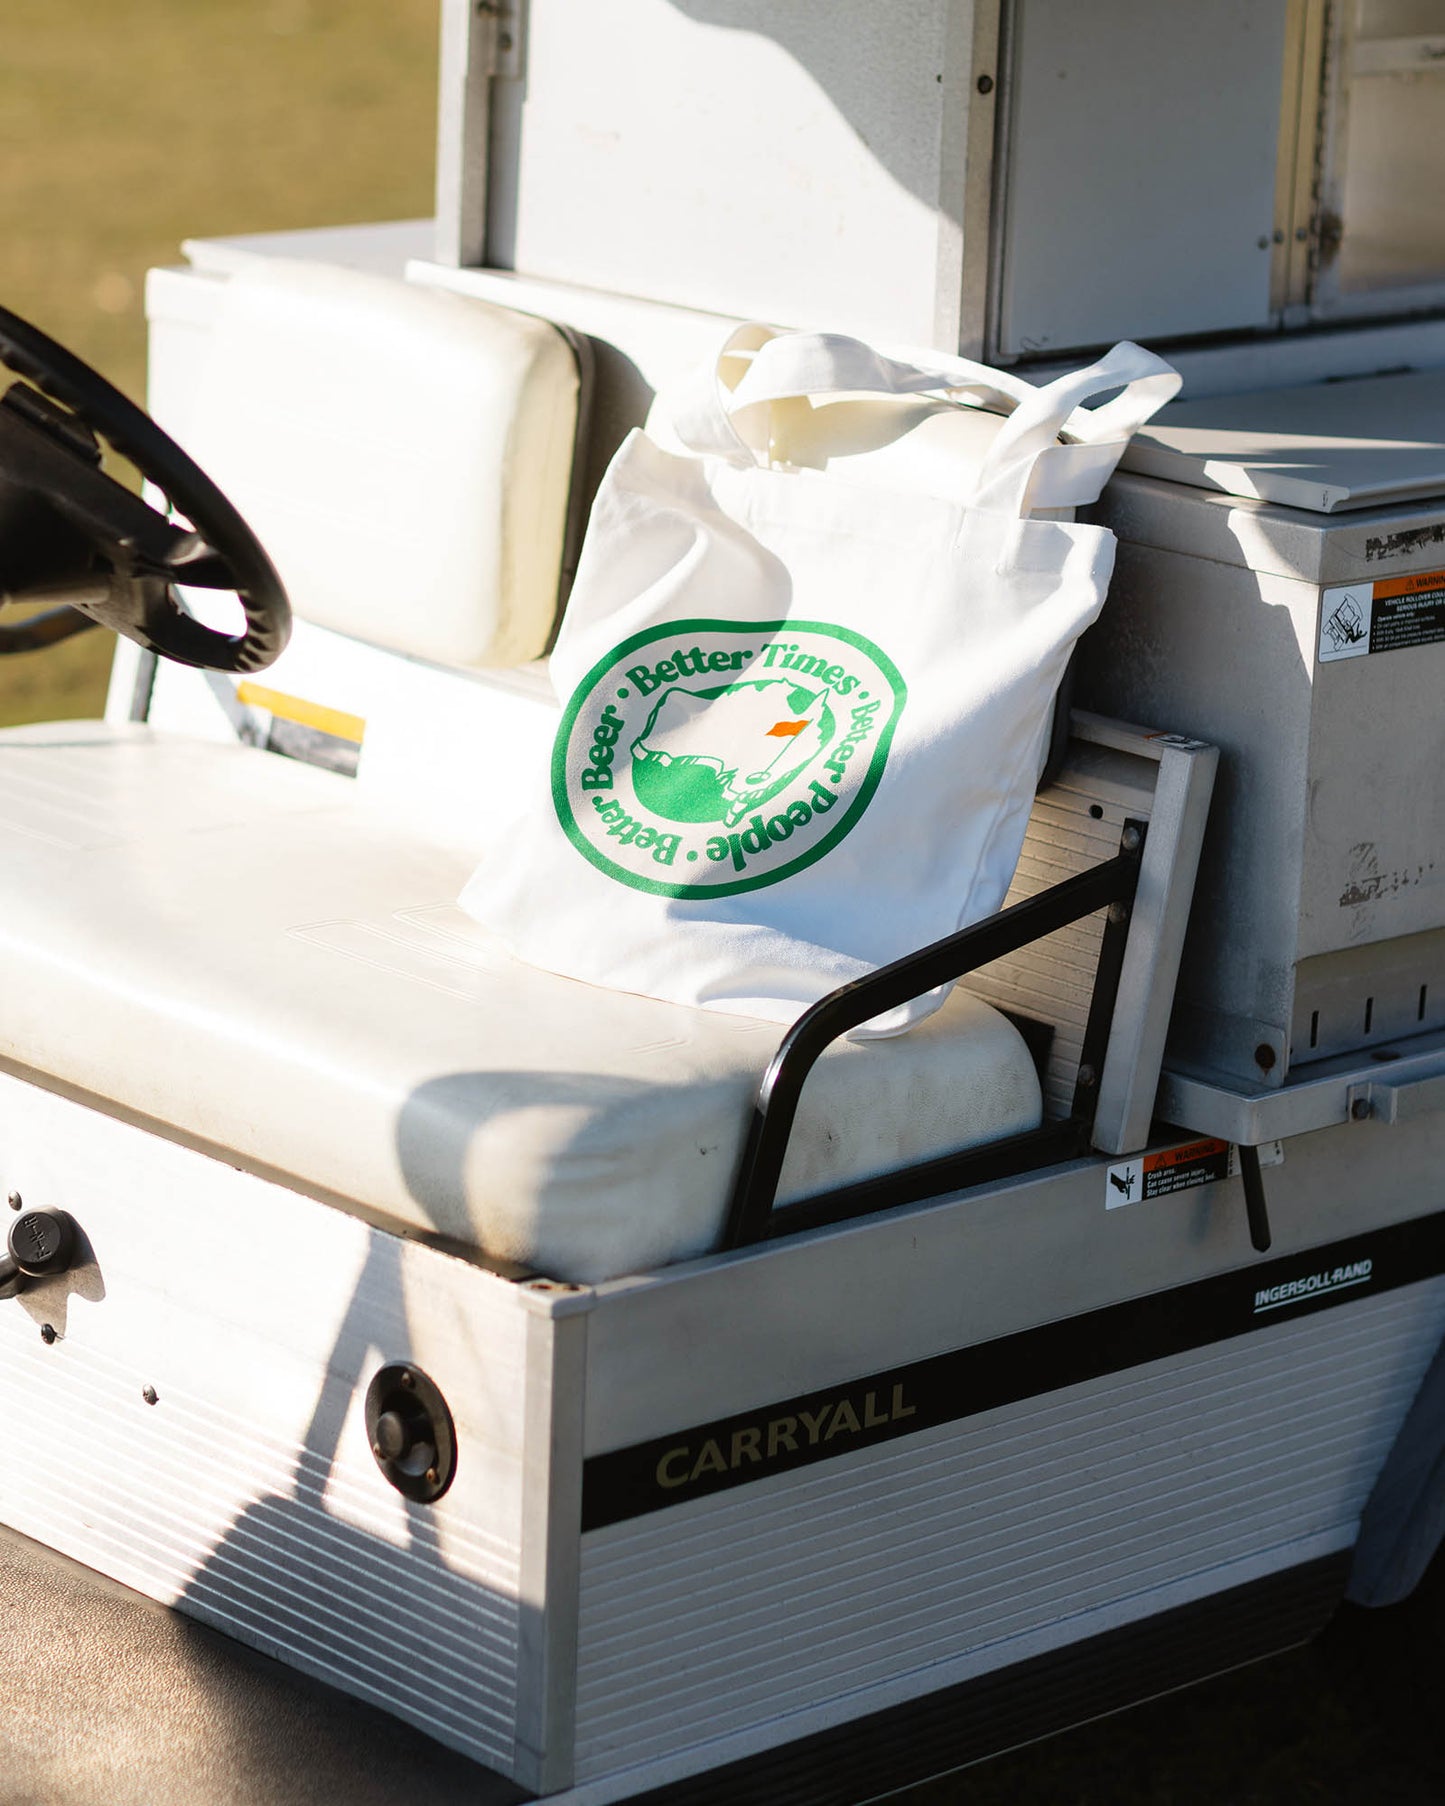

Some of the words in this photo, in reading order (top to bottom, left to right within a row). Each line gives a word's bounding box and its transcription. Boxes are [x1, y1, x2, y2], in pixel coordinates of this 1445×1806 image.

[625, 647, 753, 697] Better
[761, 643, 862, 697] Times
[581, 704, 625, 791] Beer
[823, 699, 881, 784] Better
[592, 795, 683, 866] Better
[706, 780, 839, 872] People
[1147, 1171, 1162, 1180] Crush
[1175, 1142, 1215, 1161] WARNING
[1146, 1189, 1158, 1198] Stay
[1159, 1184, 1172, 1193] clear
[1172, 1181, 1186, 1190] when
[1186, 1177, 1204, 1186] closing
[1147, 1180, 1157, 1188] Can
[1158, 1177, 1173, 1185] cause
[1255, 1259, 1372, 1307] INGERSOLL-RAND
[655, 1384, 917, 1489] CARRYALL
